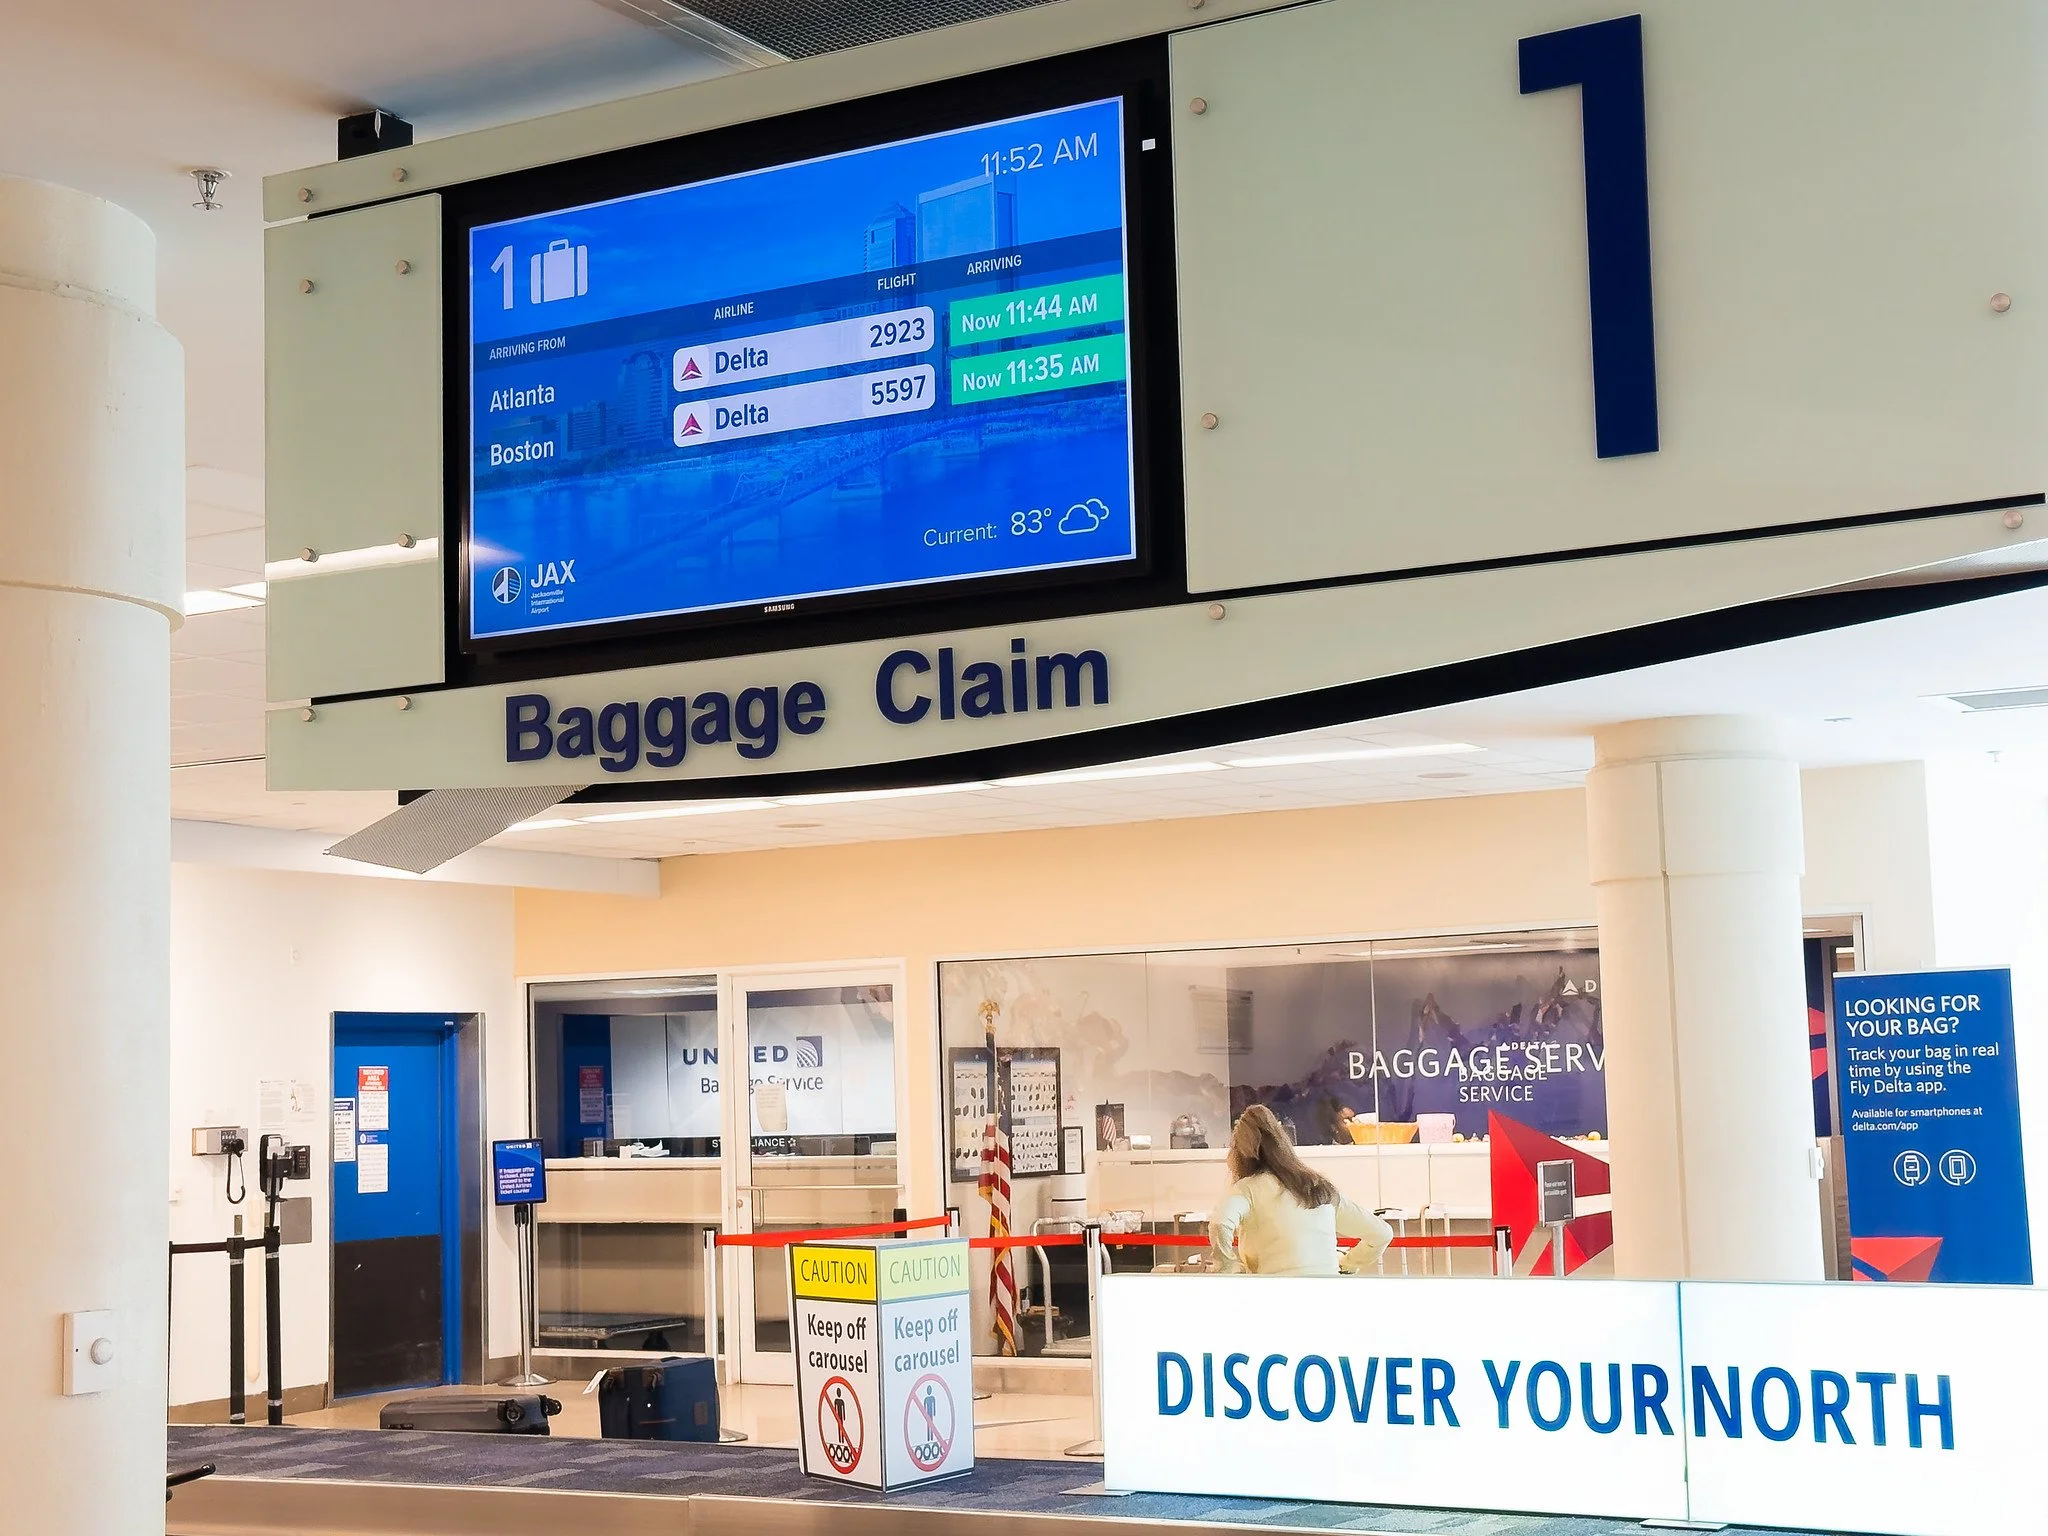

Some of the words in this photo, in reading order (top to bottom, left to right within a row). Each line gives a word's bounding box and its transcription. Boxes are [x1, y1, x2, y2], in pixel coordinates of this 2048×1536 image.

[981, 143, 1043, 177] 11:52
[1053, 132, 1098, 165] AM
[1517, 13, 1660, 459] 1
[490, 245, 514, 310] 1
[966, 254, 1022, 275] ARRIVING
[877, 272, 916, 290] FLIGHT
[714, 302, 754, 320] AIRLINE
[962, 313, 1001, 333] Now
[1006, 294, 1062, 325] 11:44
[1068, 293, 1098, 316] AM
[869, 317, 925, 348] 2923
[489, 342, 535, 360] ARRIVING
[537, 336, 566, 352] FROM
[715, 347, 769, 374] Delta
[963, 372, 1002, 392] Now
[1007, 353, 1063, 385] 11:35
[1070, 353, 1099, 376] AM
[490, 384, 555, 413] Atlanta
[871, 375, 926, 405] 5597
[715, 403, 769, 430] Delta
[490, 440, 554, 466] Boston
[924, 523, 997, 546] Current:
[530, 559, 576, 588] JAX
[764, 603, 795, 613] SAMSUNG
[505, 680, 827, 773] Baggage
[875, 638, 1110, 726] Claim
[1845, 996, 1936, 1017] LOOKING
[1941, 994, 1981, 1012] FOR
[1846, 1019, 1902, 1038] YOUR
[1908, 1016, 1960, 1035] BAG?
[683, 1045, 789, 1065] UNED
[1348, 1046, 1512, 1080] BAGGAGE
[1848, 1046, 1886, 1061] Track
[1889, 1048, 1921, 1062] your
[1925, 1044, 1951, 1060] bag
[1955, 1044, 1968, 1057] in
[1972, 1042, 1999, 1056] real
[1459, 1064, 1547, 1082] BAGGAGE
[1849, 1064, 1881, 1077] time
[1884, 1064, 1901, 1079] by
[1906, 1063, 1943, 1077] using
[1947, 1061, 1971, 1075] the
[1460, 1085, 1534, 1102] SERVICE
[1850, 1080, 1870, 1096] Fly
[1874, 1078, 1912, 1094] Delta
[1916, 1081, 1947, 1095] app.
[1852, 1108, 1893, 1118] Available
[1895, 1107, 1908, 1117] for
[1910, 1107, 1971, 1118] smartphones
[1973, 1107, 1983, 1116] at
[1852, 1121, 1919, 1131] delta.com/app
[801, 1259, 868, 1285] CAUTION
[890, 1254, 960, 1284] CAUTION
[807, 1313, 843, 1344] Keep
[847, 1317, 866, 1340] off
[894, 1314, 933, 1342] Keep
[938, 1308, 958, 1333] off
[808, 1349, 868, 1373] carousel
[894, 1340, 959, 1373] carousel
[1156, 1351, 1460, 1428] DISCOVER
[1481, 1359, 1675, 1437] YOUR
[1694, 1364, 1955, 1451] NORTH
